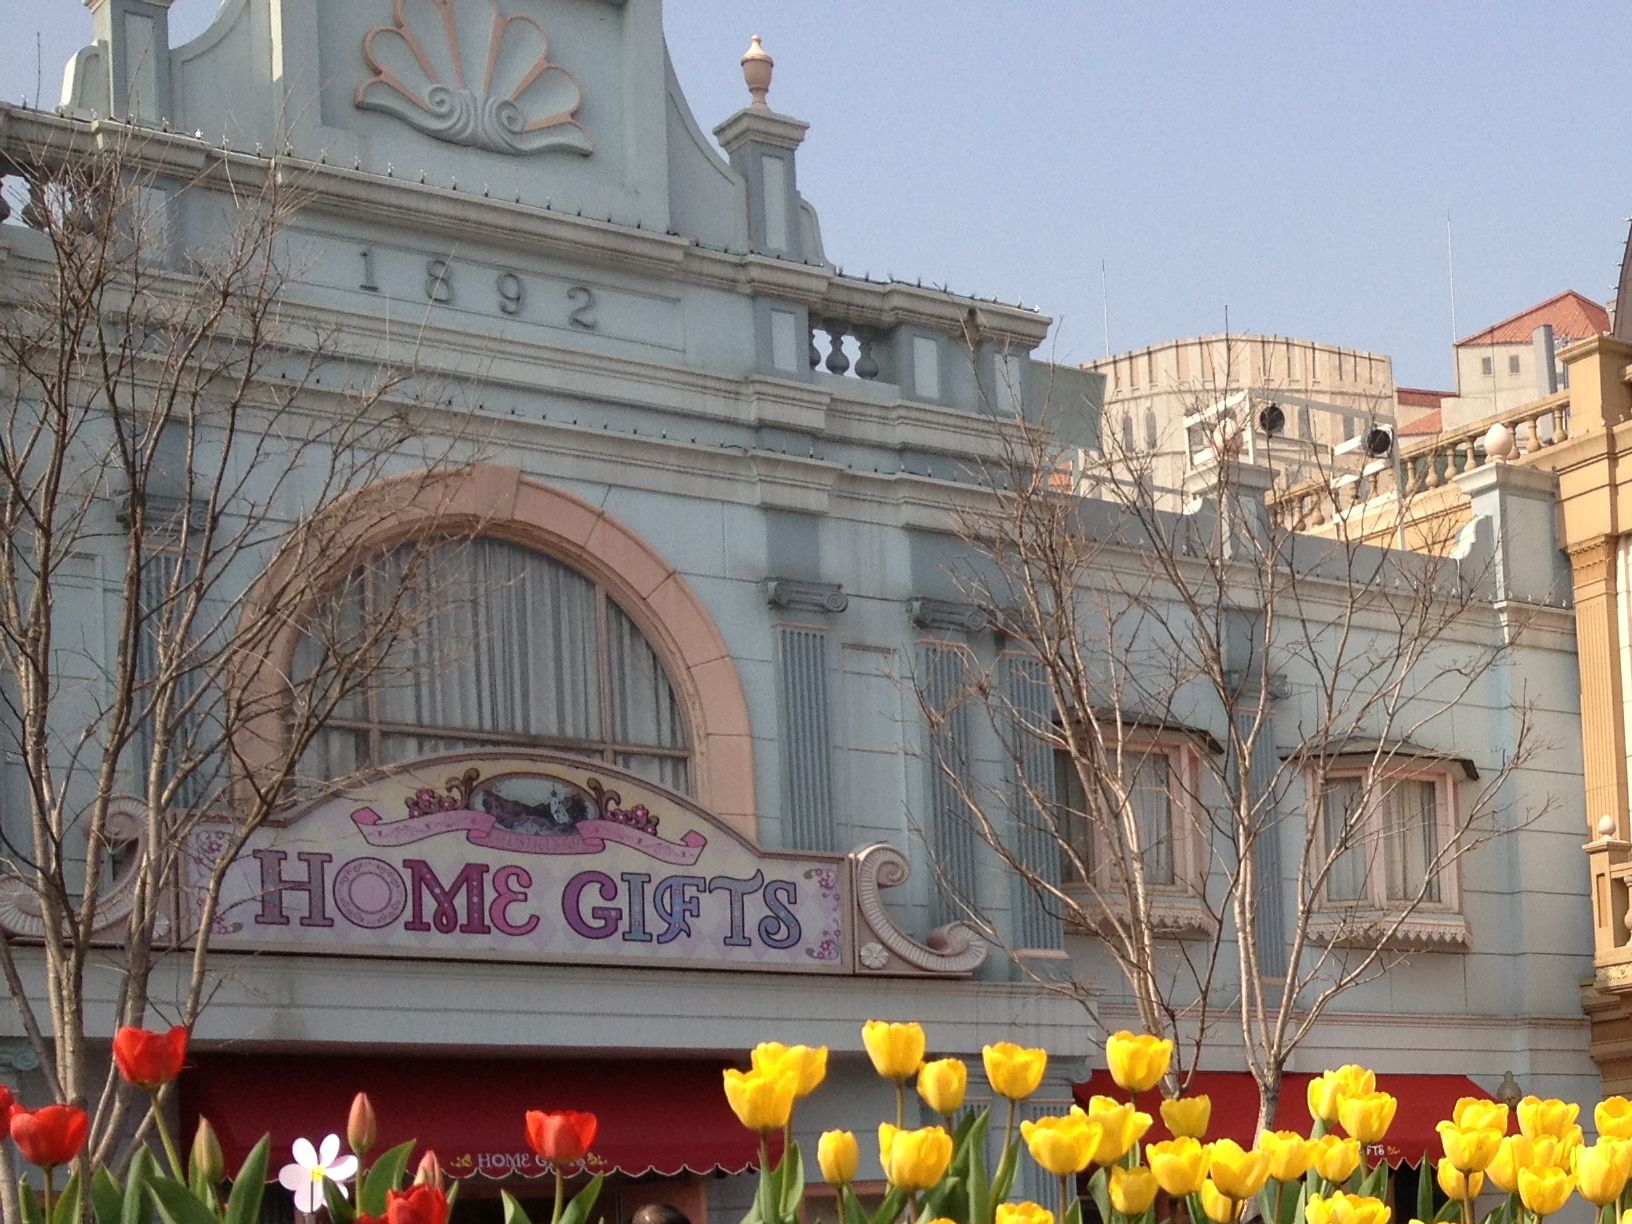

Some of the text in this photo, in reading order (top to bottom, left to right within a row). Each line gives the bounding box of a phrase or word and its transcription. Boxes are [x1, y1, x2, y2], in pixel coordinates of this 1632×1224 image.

[359, 251, 597, 331] 1892
[253, 850, 802, 949] HOME GIFTS
[478, 1153, 531, 1168] HOME
